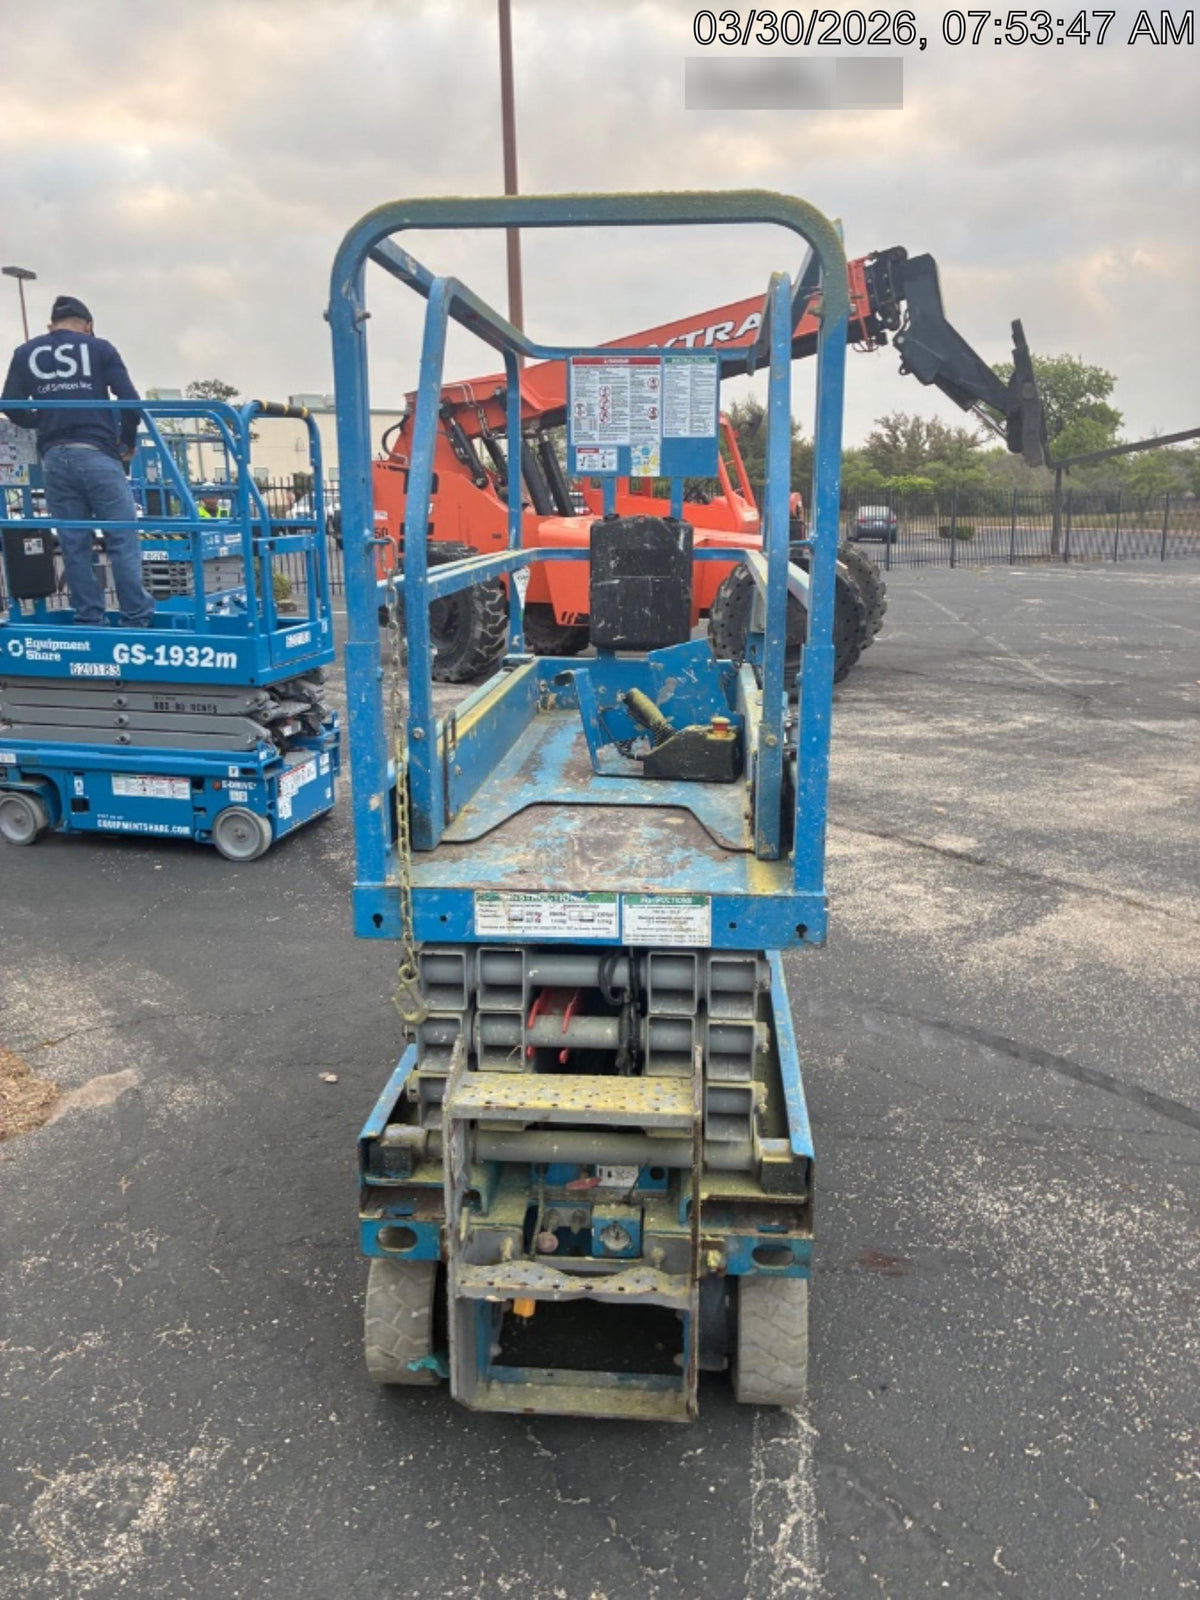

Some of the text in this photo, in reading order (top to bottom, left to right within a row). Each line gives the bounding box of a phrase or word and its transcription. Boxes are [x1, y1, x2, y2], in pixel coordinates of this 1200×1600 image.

[28, 343, 92, 379] CSI
[25, 637, 92, 652] Equipment
[26, 650, 62, 662] Share
[112, 643, 238, 669] GS-1932m
